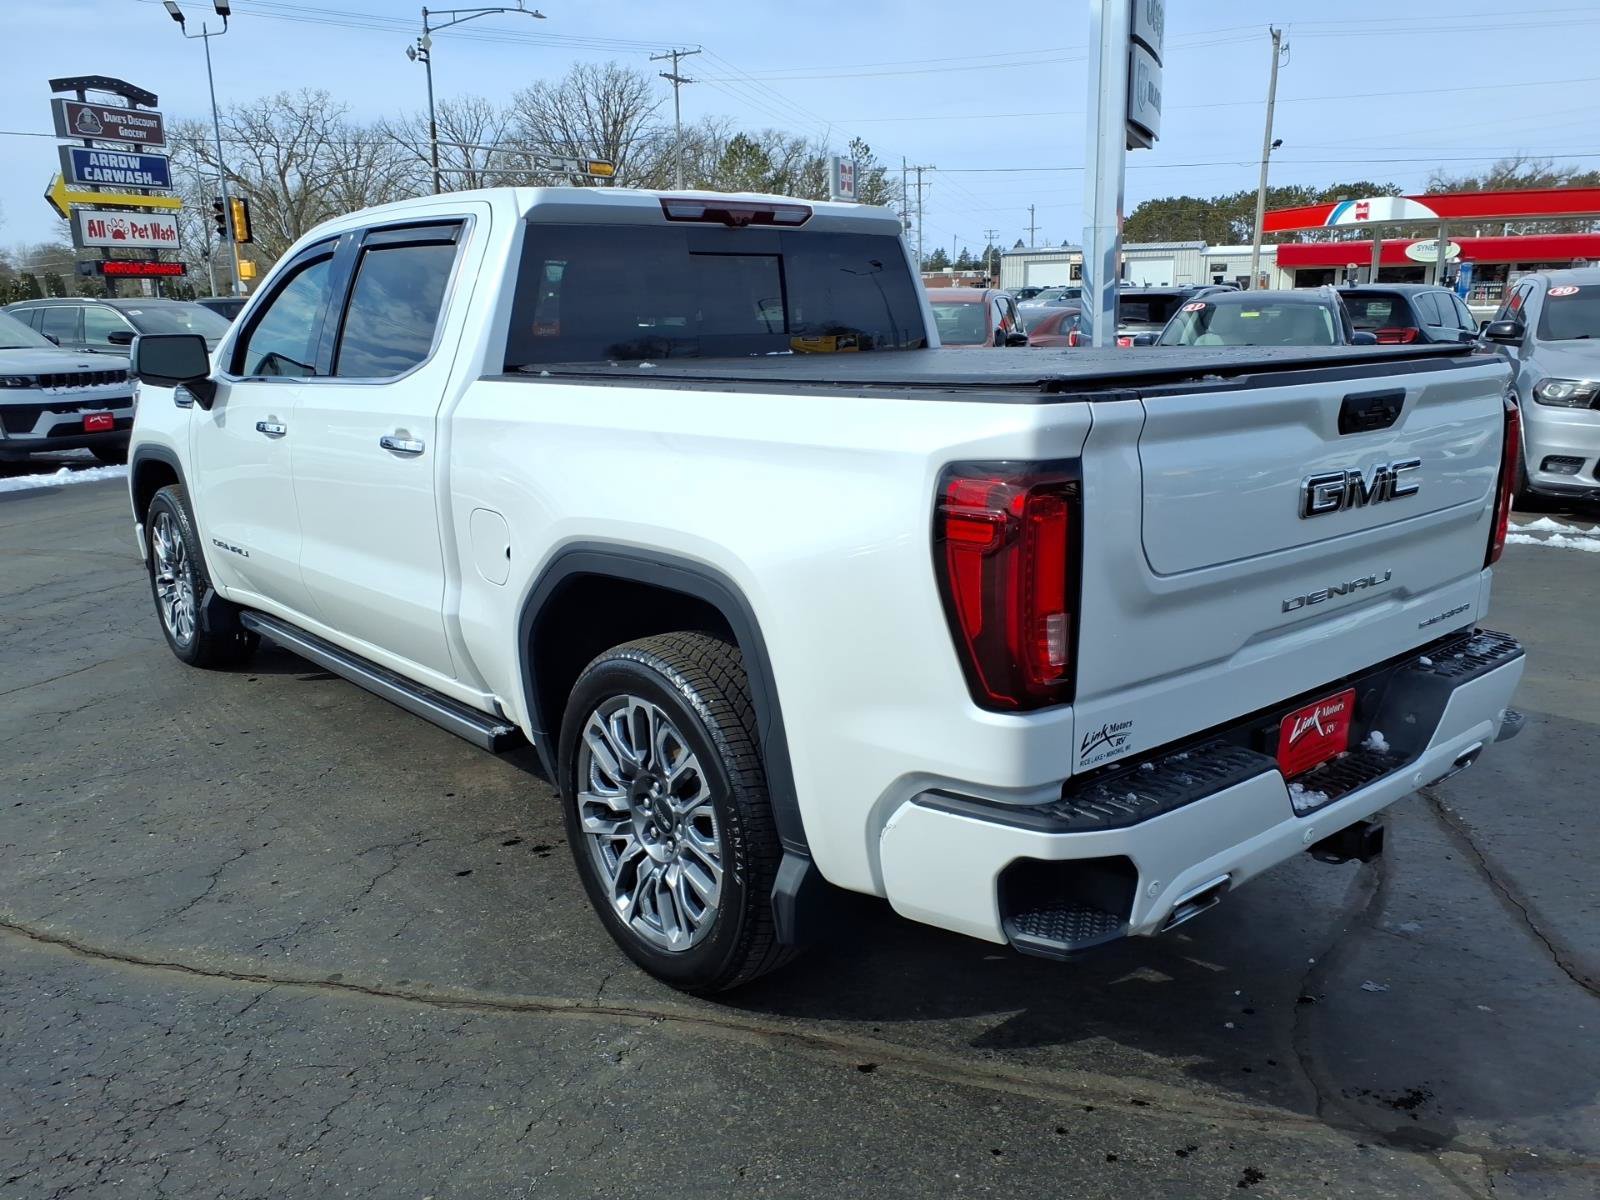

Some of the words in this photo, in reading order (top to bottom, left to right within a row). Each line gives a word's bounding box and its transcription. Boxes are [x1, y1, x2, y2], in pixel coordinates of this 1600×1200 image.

[89, 152, 141, 170] ARROW
[87, 219, 106, 238] All
[130, 221, 150, 240] Pet
[150, 221, 176, 241] Wash
[1298, 456, 1422, 520] GMC
[1281, 568, 1392, 613] DENALI
[1080, 723, 1114, 752] Link
[1109, 720, 1134, 733] Motors
[1288, 706, 1325, 744] Link
[1322, 703, 1345, 717] Motors
